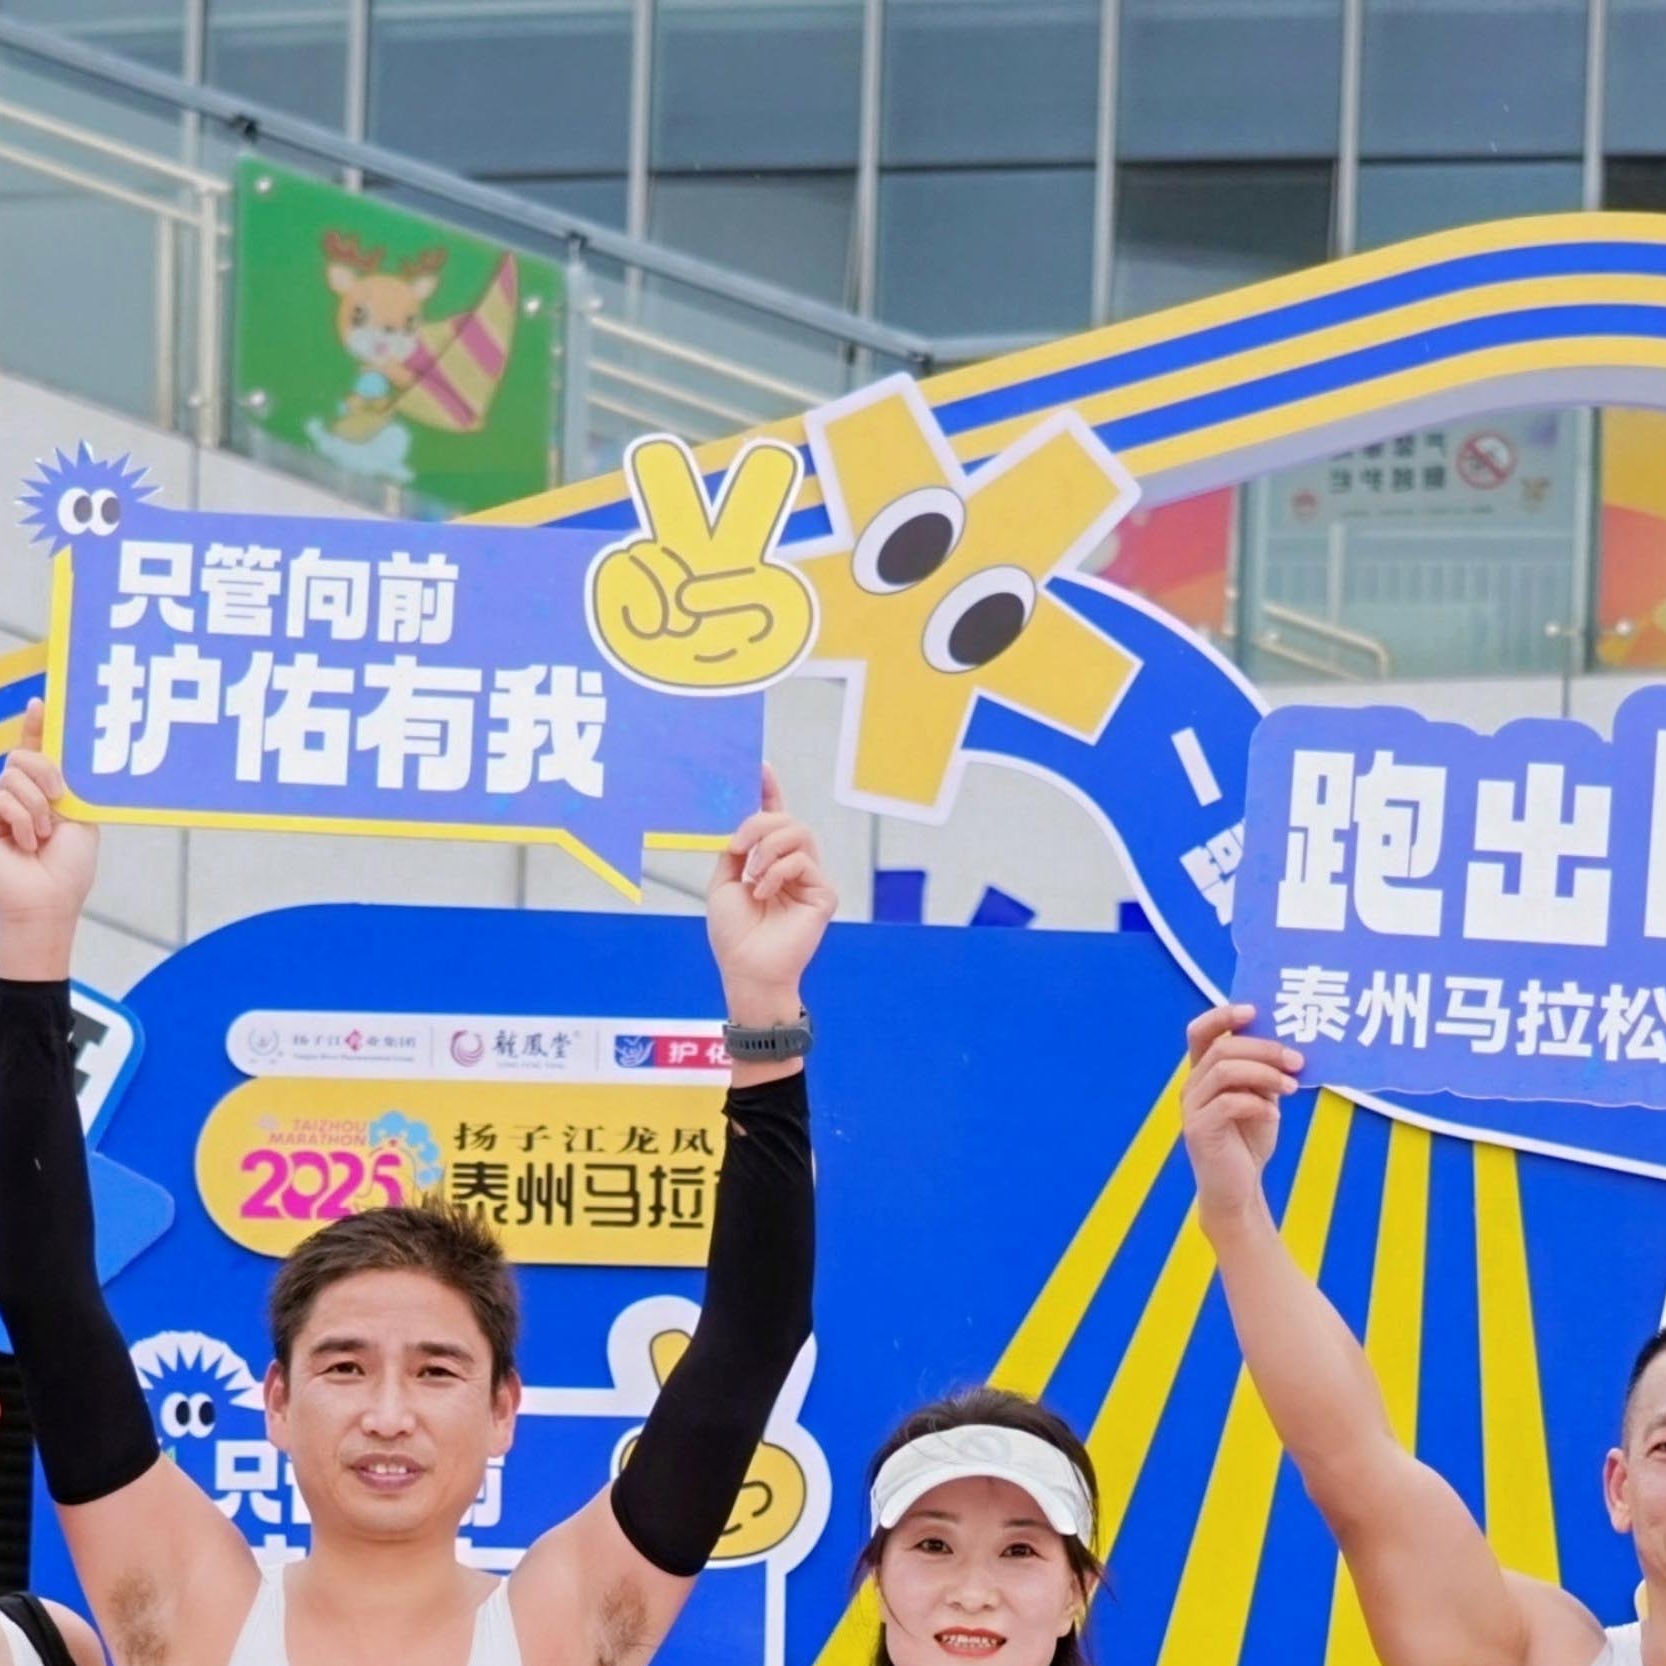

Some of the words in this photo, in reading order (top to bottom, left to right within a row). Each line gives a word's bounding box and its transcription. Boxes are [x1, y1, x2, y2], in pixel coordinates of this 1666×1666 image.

[109, 540, 459, 645] 只管向前
[91, 643, 608, 800] 护佑有我
[268, 1132, 367, 1146] MARATHON
[292, 1119, 368, 1132] TAIZHOU
[452, 1121, 714, 1156] 扬子江龙凤
[240, 1148, 403, 1221] 2025
[451, 1161, 721, 1229] 泰州马拉
